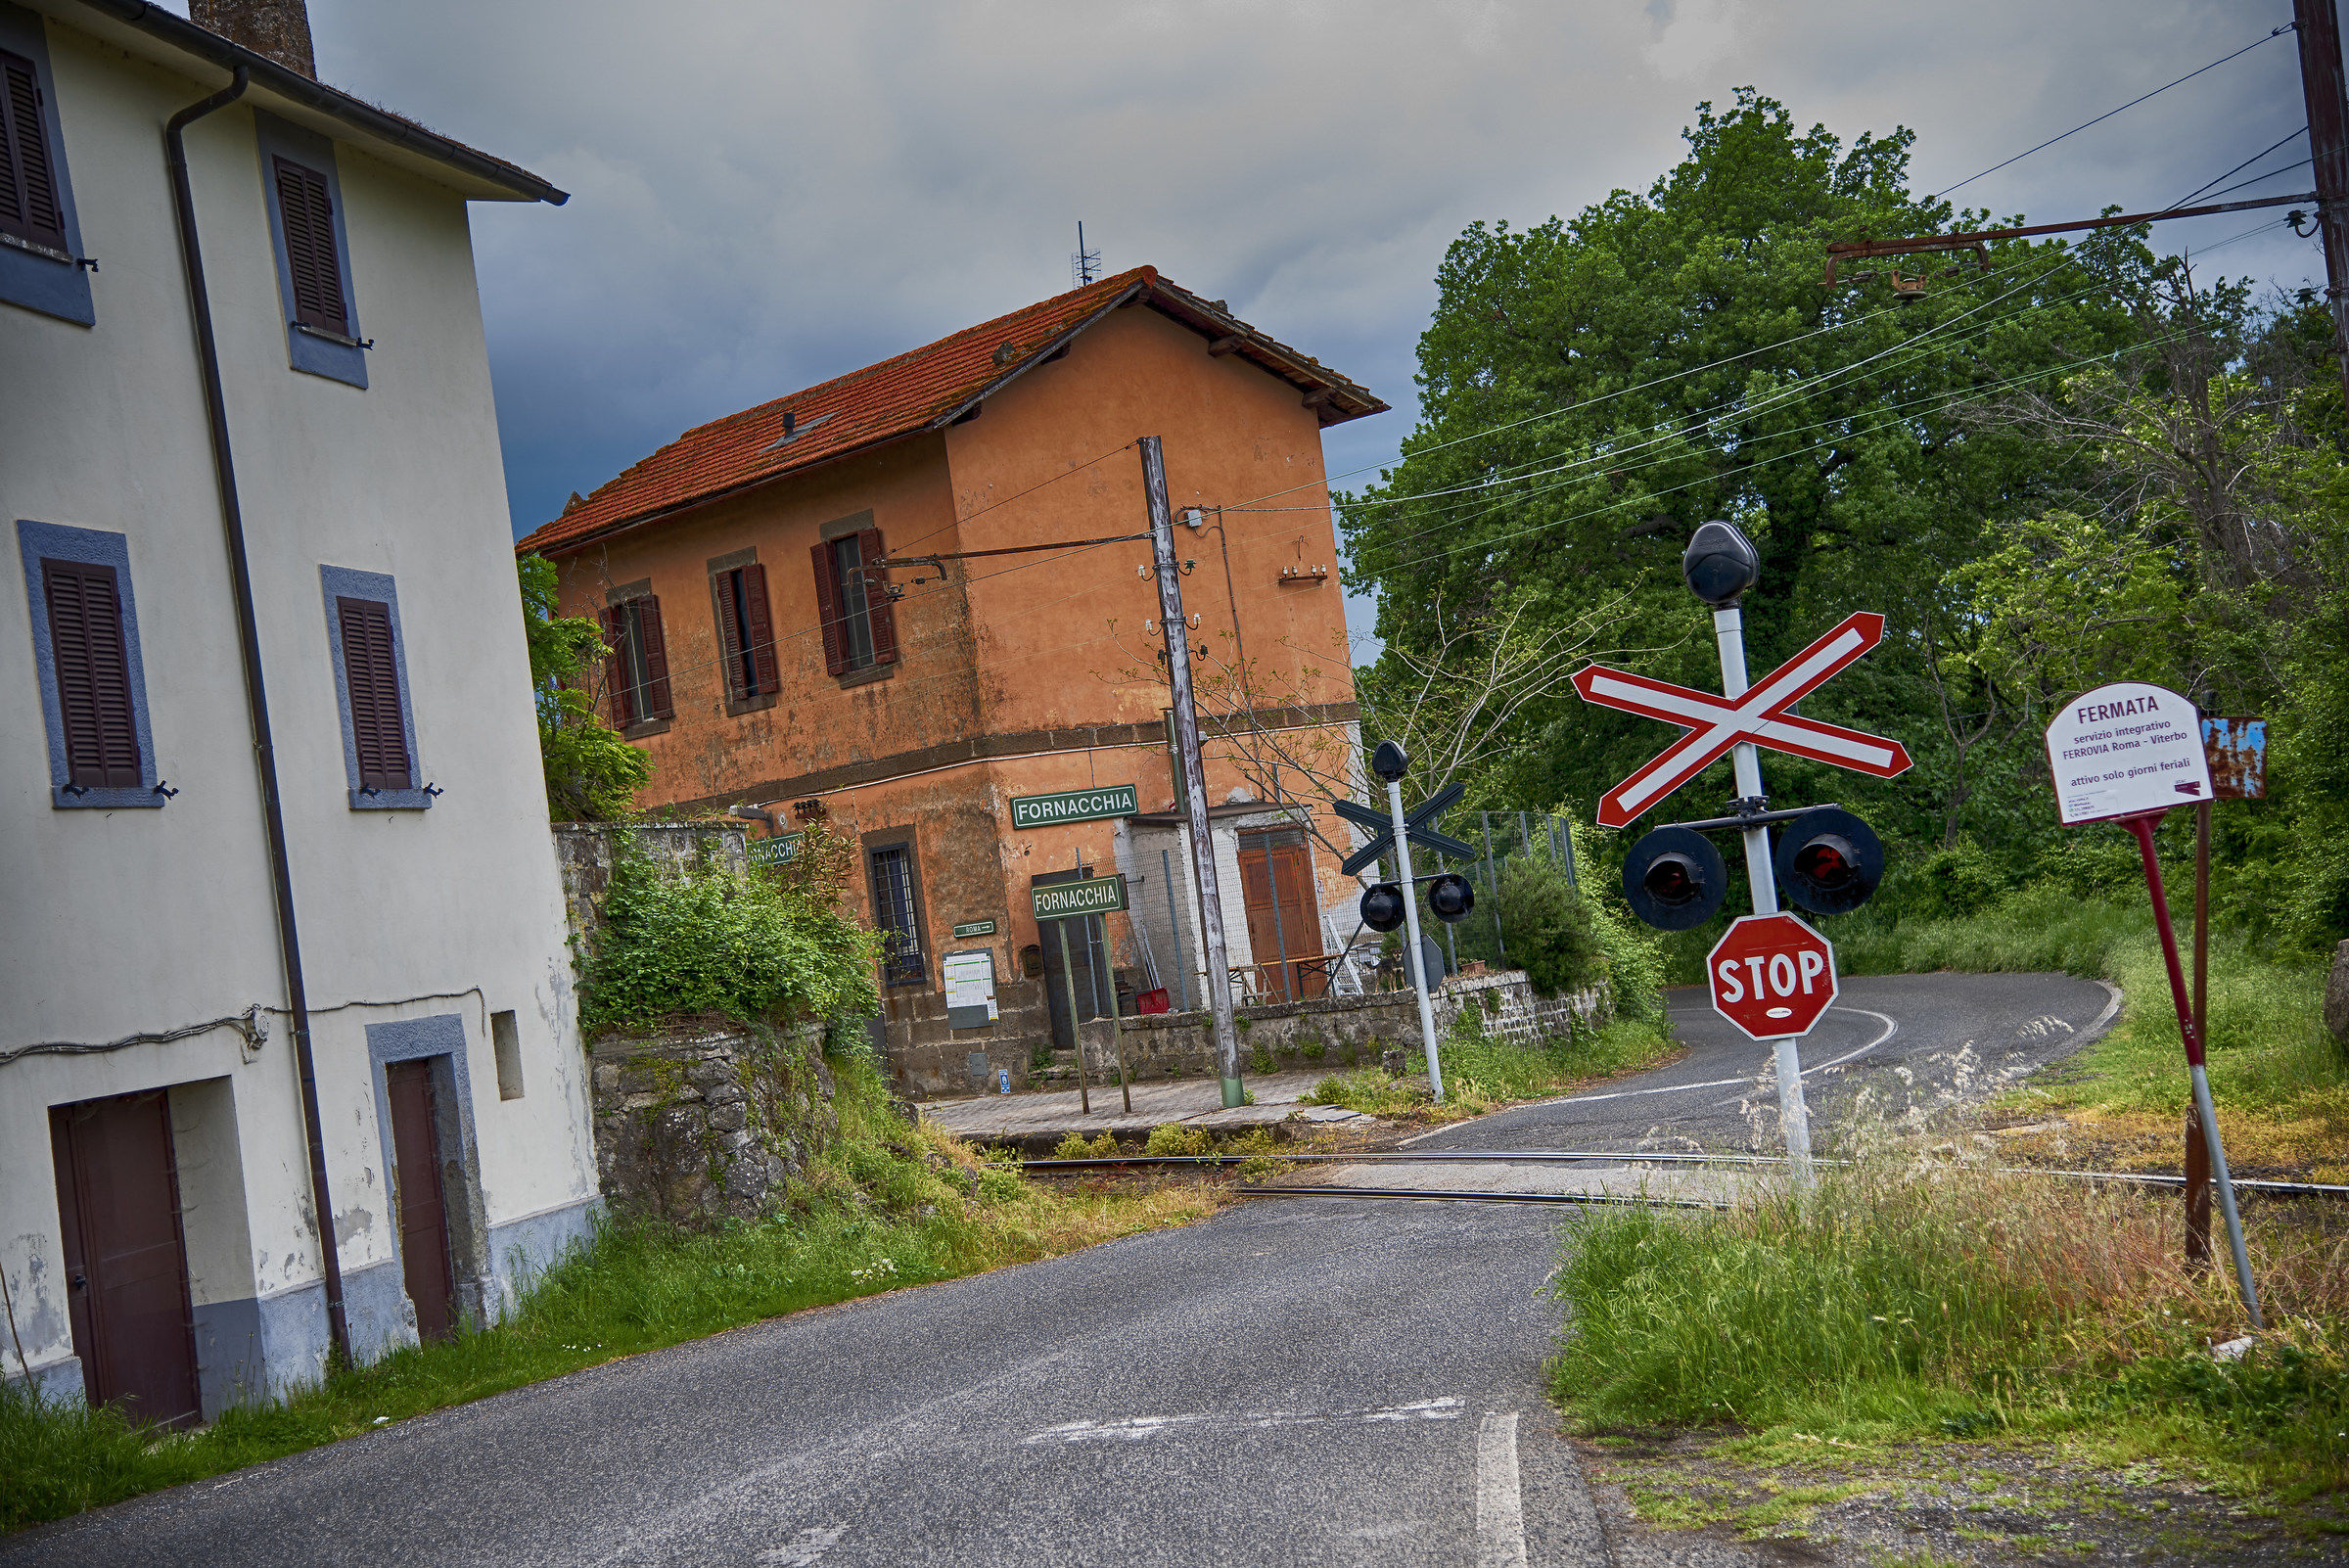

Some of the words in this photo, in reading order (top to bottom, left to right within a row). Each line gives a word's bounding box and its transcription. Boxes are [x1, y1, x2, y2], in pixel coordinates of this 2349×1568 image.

[2077, 695, 2159, 724] FERMATA
[2062, 744, 2109, 761] FERROVIA
[2112, 740, 2141, 752] Roma
[2150, 731, 2188, 745] Viterbo
[2074, 728, 2112, 745] servizio
[2115, 719, 2171, 738] integrativo
[2071, 774, 2100, 787] attivo
[2103, 769, 2125, 781] solo
[2128, 763, 2158, 779] giorni
[2160, 758, 2190, 772] feriali
[1018, 793, 1131, 820] FORNACCHIA
[1035, 885, 1117, 912] FORNACCHIA
[965, 925, 981, 934] ROMA
[1718, 949, 1823, 1003] STOP
